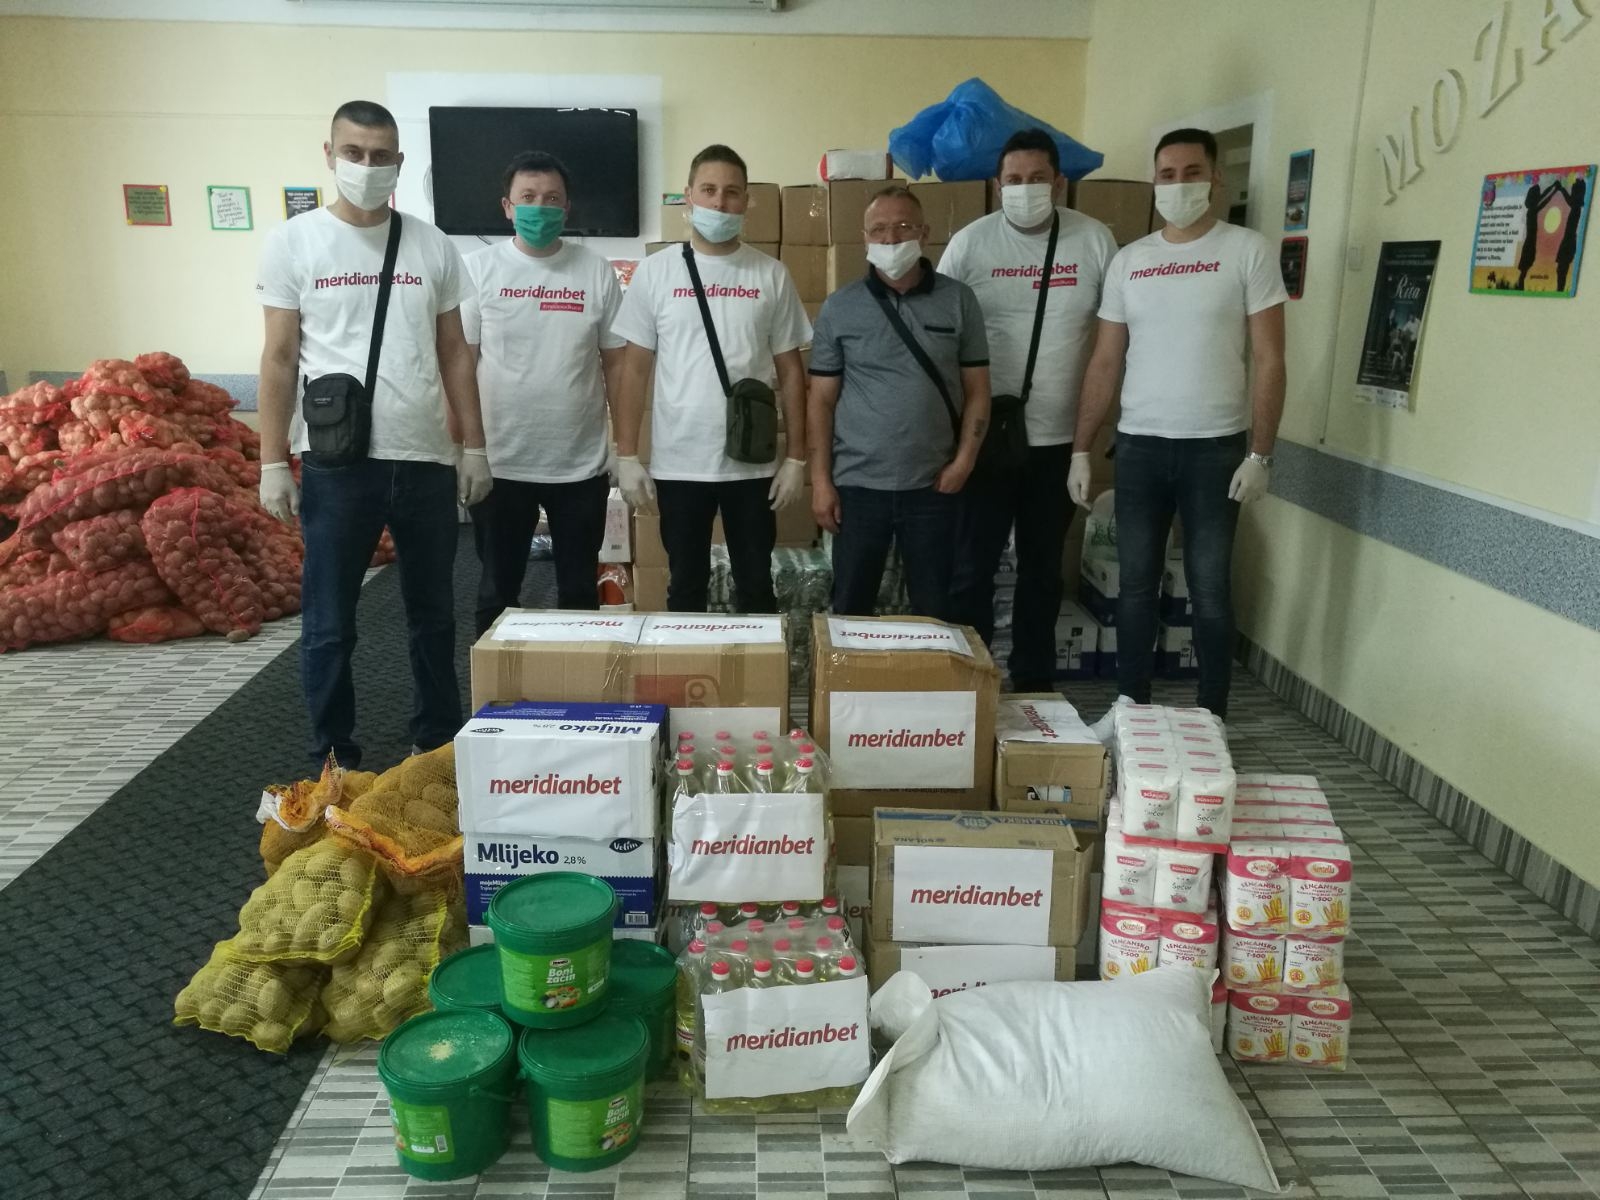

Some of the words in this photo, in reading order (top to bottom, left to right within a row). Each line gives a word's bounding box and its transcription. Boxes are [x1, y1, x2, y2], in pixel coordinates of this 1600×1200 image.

[1129, 260, 1221, 280] meridianbet
[315, 271, 423, 290] meridianet.ba
[499, 284, 586, 301] meridianbet
[673, 283, 760, 299] meidianbet
[839, 631, 951, 640] meridianbet
[559, 724, 642, 734] Mlijeko
[848, 728, 967, 749] meridianbet
[489, 773, 622, 795] meridianbet
[691, 833, 815, 856] meridianbet
[477, 843, 560, 869] Mlijeko
[910, 884, 1043, 907] meridianbet
[548, 964, 574, 977] Boni
[726, 1022, 859, 1052] meridianbet
